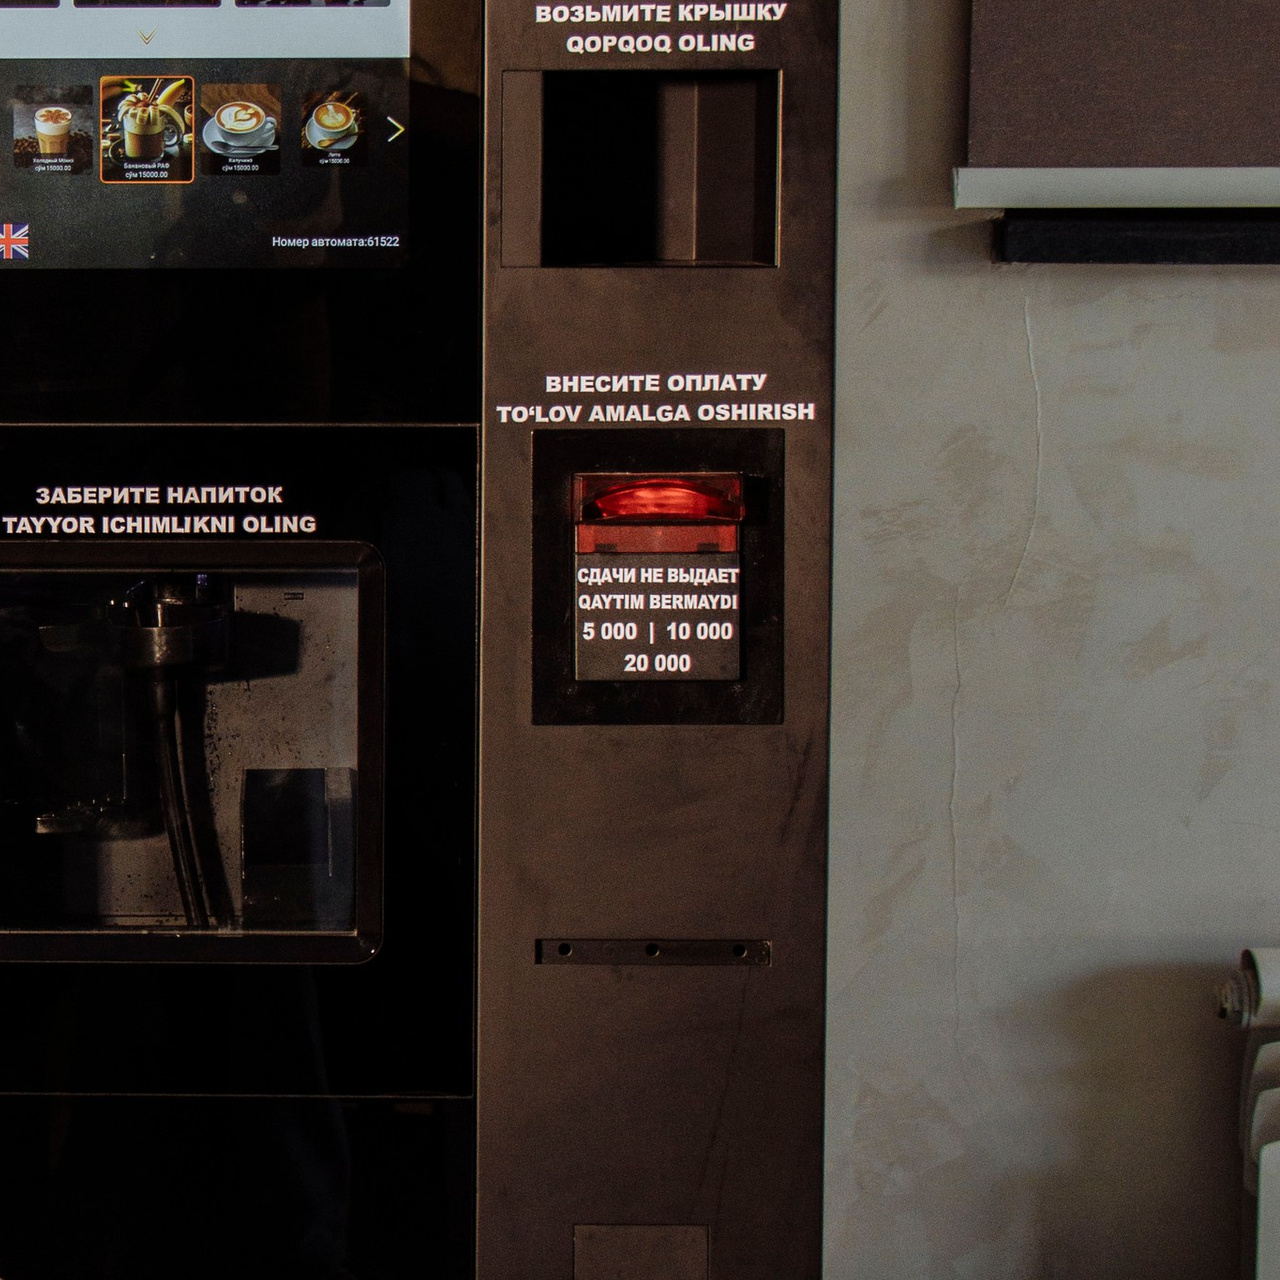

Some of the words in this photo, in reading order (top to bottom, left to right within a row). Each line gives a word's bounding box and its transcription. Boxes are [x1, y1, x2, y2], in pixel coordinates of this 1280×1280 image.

[535, 4, 671, 22] ВОЗЬМИТЕ
[678, 3, 787, 21] КРЫШКУ
[566, 35, 672, 54] QOPQOQ
[678, 34, 755, 52] OLING
[272, 237, 309, 249] Номер
[545, 374, 660, 393] ВНЕСИТЕ
[668, 374, 767, 392] ОПЛАТУ
[589, 404, 691, 422] AMALGA
[697, 403, 815, 421] OSHIRISH
[36, 487, 160, 504] ЗАБЕРИТЕ
[168, 486, 282, 504] НАПИТОК
[2, 517, 96, 534] TAYYOR
[102, 516, 235, 534] ICHIMLIKNI
[242, 516, 316, 533] OLING
[577, 569, 636, 586] СДАЧИ
[640, 569, 663, 583] НЕ
[667, 569, 740, 586] ВЫДАЕТ
[578, 595, 644, 610] QAYTIM
[649, 594, 738, 609] BERMAYDI
[582, 623, 594, 640] 5
[601, 623, 637, 639] 000
[667, 623, 690, 640] 10
[697, 623, 733, 639] 000
[624, 655, 648, 671] 20
[654, 655, 691, 671] 000
